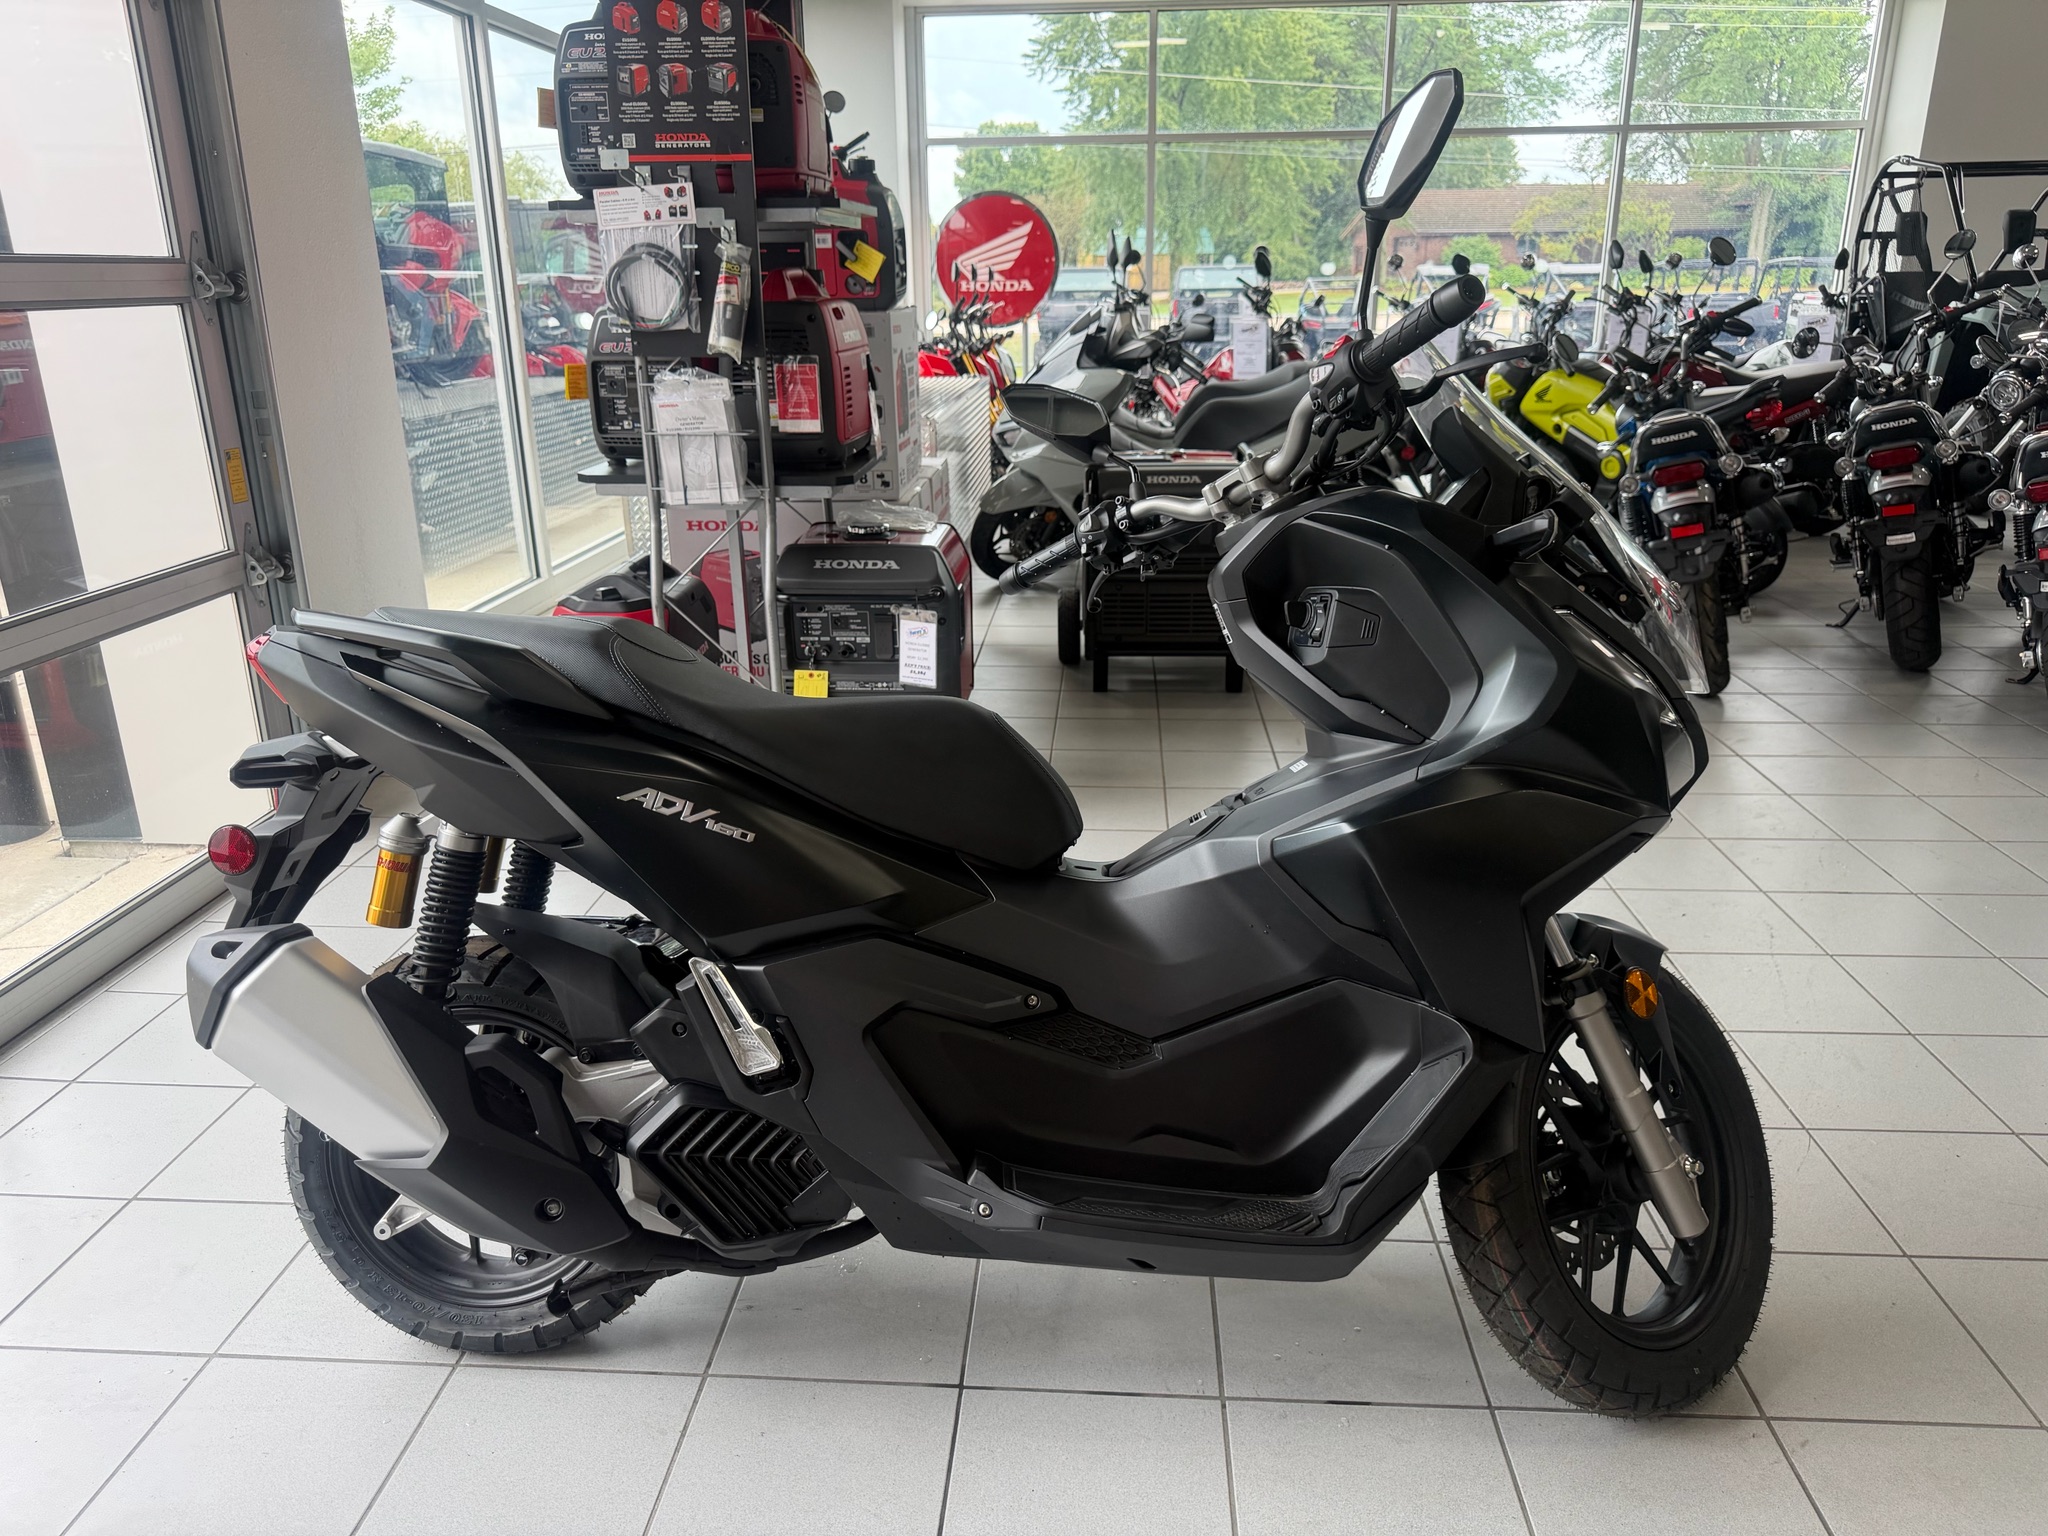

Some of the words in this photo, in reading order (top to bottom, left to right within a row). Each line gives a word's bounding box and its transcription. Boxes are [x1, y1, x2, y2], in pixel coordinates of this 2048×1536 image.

[655, 133, 710, 142] HONDA
[960, 279, 1034, 292] HONDA
[1871, 417, 1919, 431] HONDA
[1651, 429, 1698, 446] HONDA
[1146, 475, 1201, 484] HONDA
[813, 559, 900, 570] HONDA
[616, 787, 720, 823] ADV
[705, 817, 756, 843] 160
